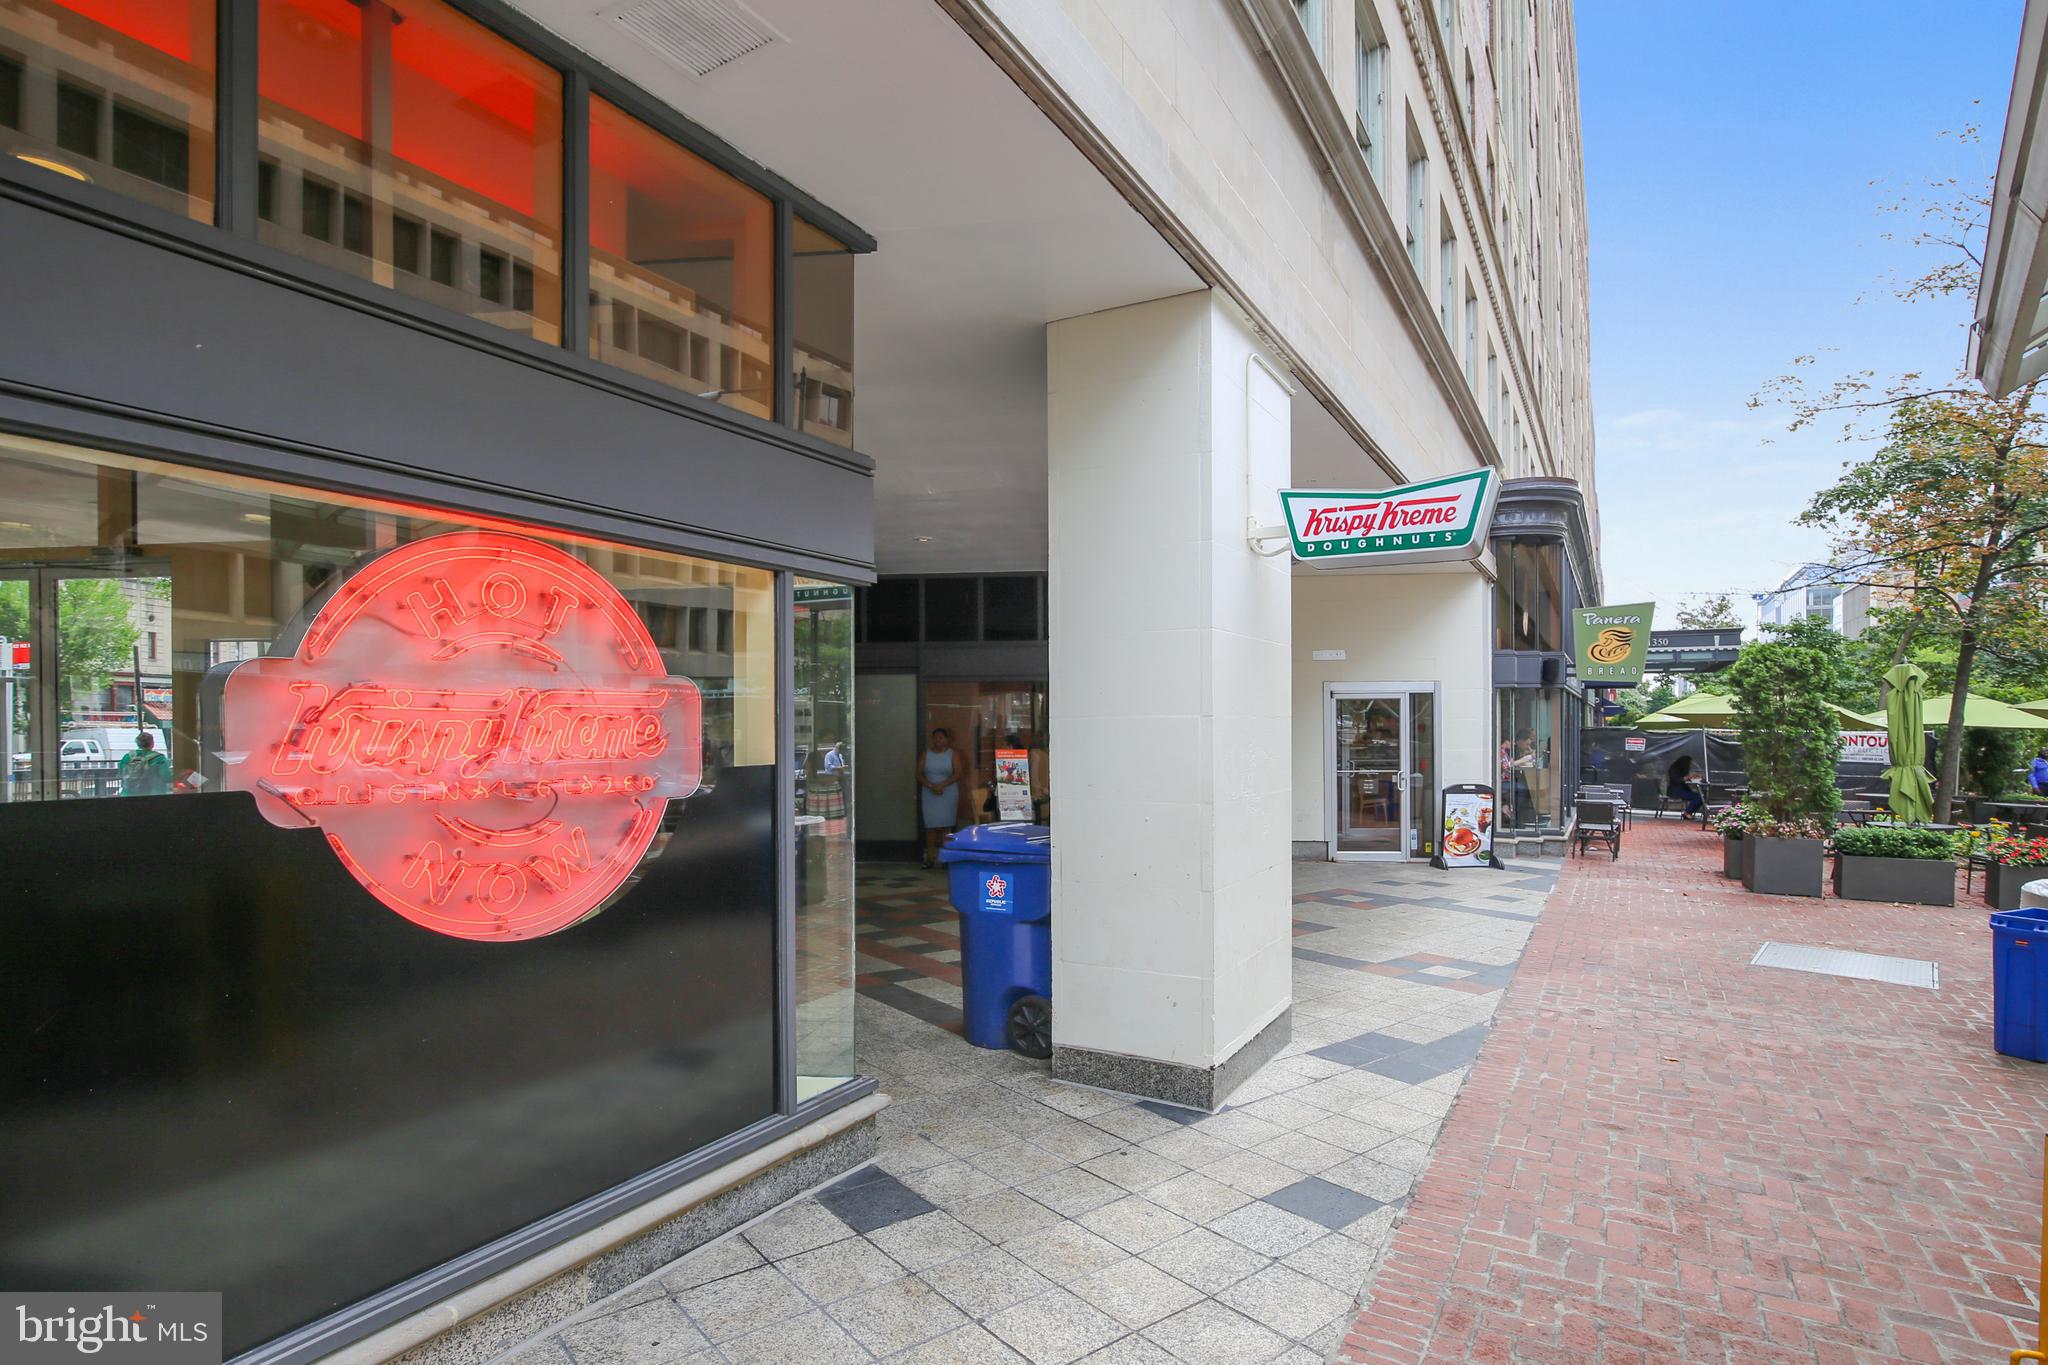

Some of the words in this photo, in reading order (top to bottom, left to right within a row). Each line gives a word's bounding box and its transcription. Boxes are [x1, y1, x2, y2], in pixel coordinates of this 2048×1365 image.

[1302, 502, 1381, 537] Krispy
[1378, 494, 1462, 531] Kreme
[1307, 532, 1453, 552] DOUGHNUTS
[406, 571, 580, 640] HOT
[1582, 612, 1641, 626] Panera
[1587, 667, 1637, 675] BREAD
[271, 682, 516, 779] Krispy
[501, 687, 669, 764] Kreme
[294, 780, 513, 804] ORIGINAL
[536, 775, 656, 796] GLAZED
[402, 826, 592, 916] NOW
